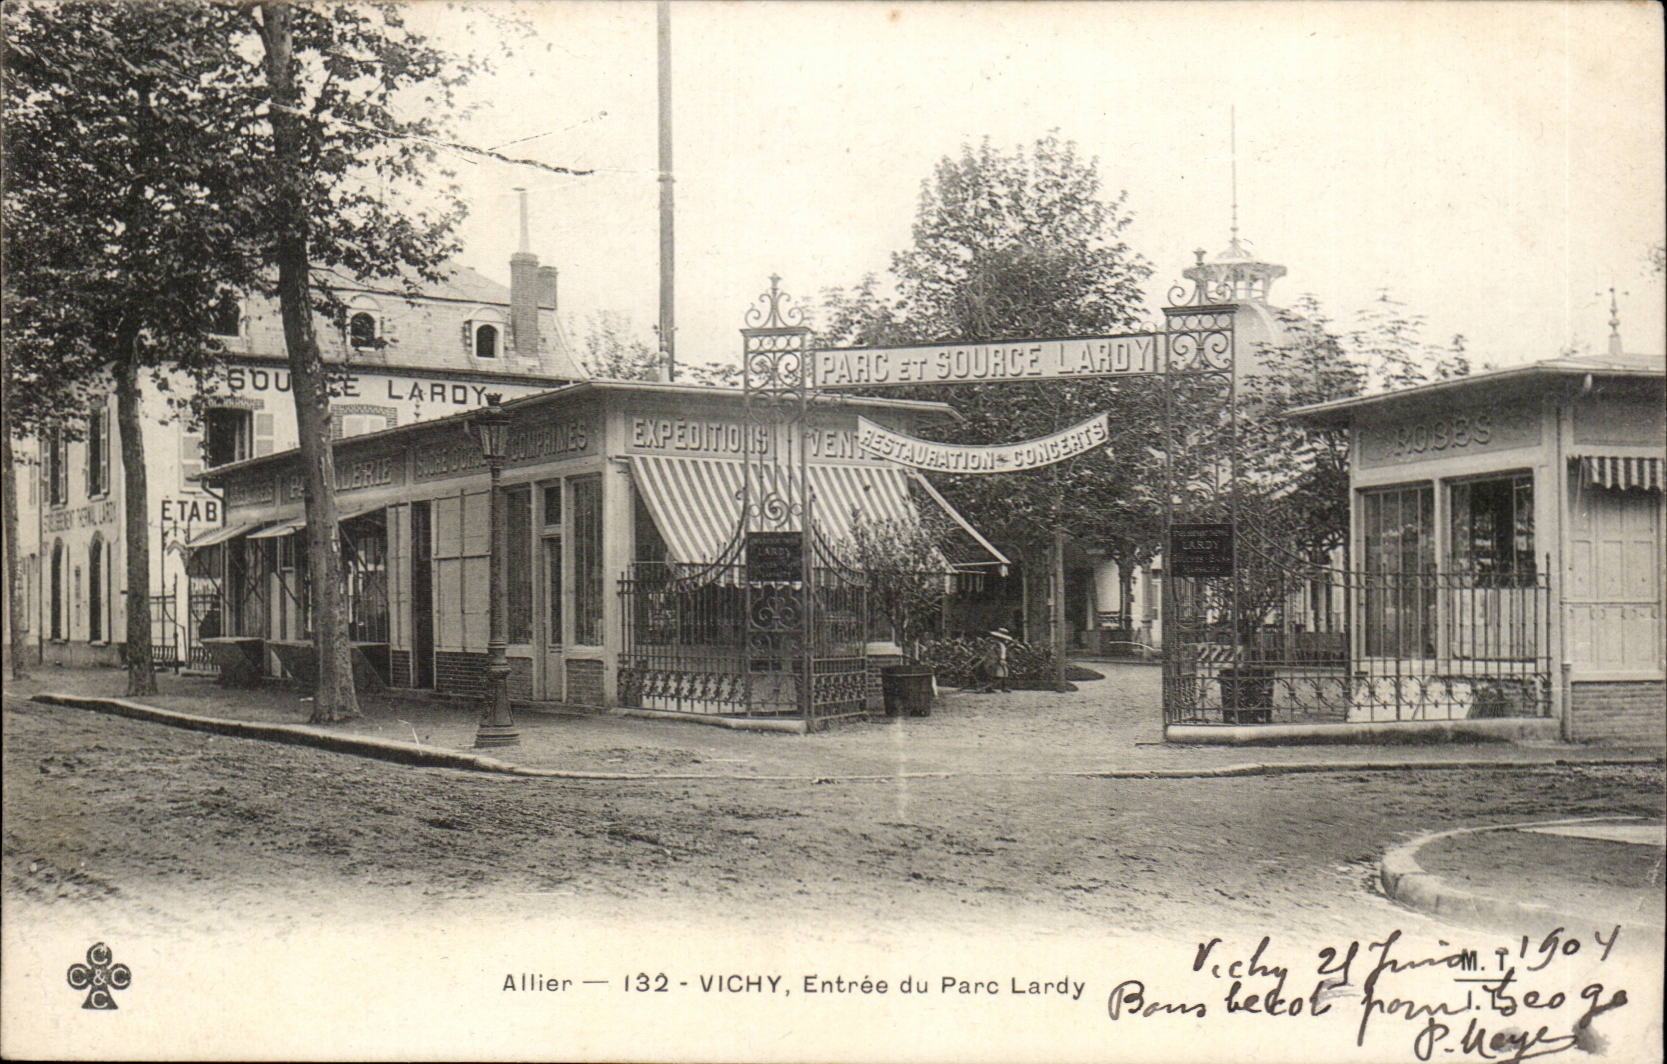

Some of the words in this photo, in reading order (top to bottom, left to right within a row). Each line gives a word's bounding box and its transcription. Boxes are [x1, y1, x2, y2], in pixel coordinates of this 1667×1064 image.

[822, 352, 889, 384] PARC
[900, 358, 928, 381] ET
[936, 344, 1042, 380] SOURCE
[1058, 338, 1151, 374] LARDY
[388, 379, 487, 406] LARDY
[860, 430, 996, 470] RESTAURATION
[1014, 422, 1107, 468] CONCERTS
[1193, 937, 1287, 1000] Vichy
[1318, 941, 1359, 990] 21
[1520, 925, 1621, 971] 1904
